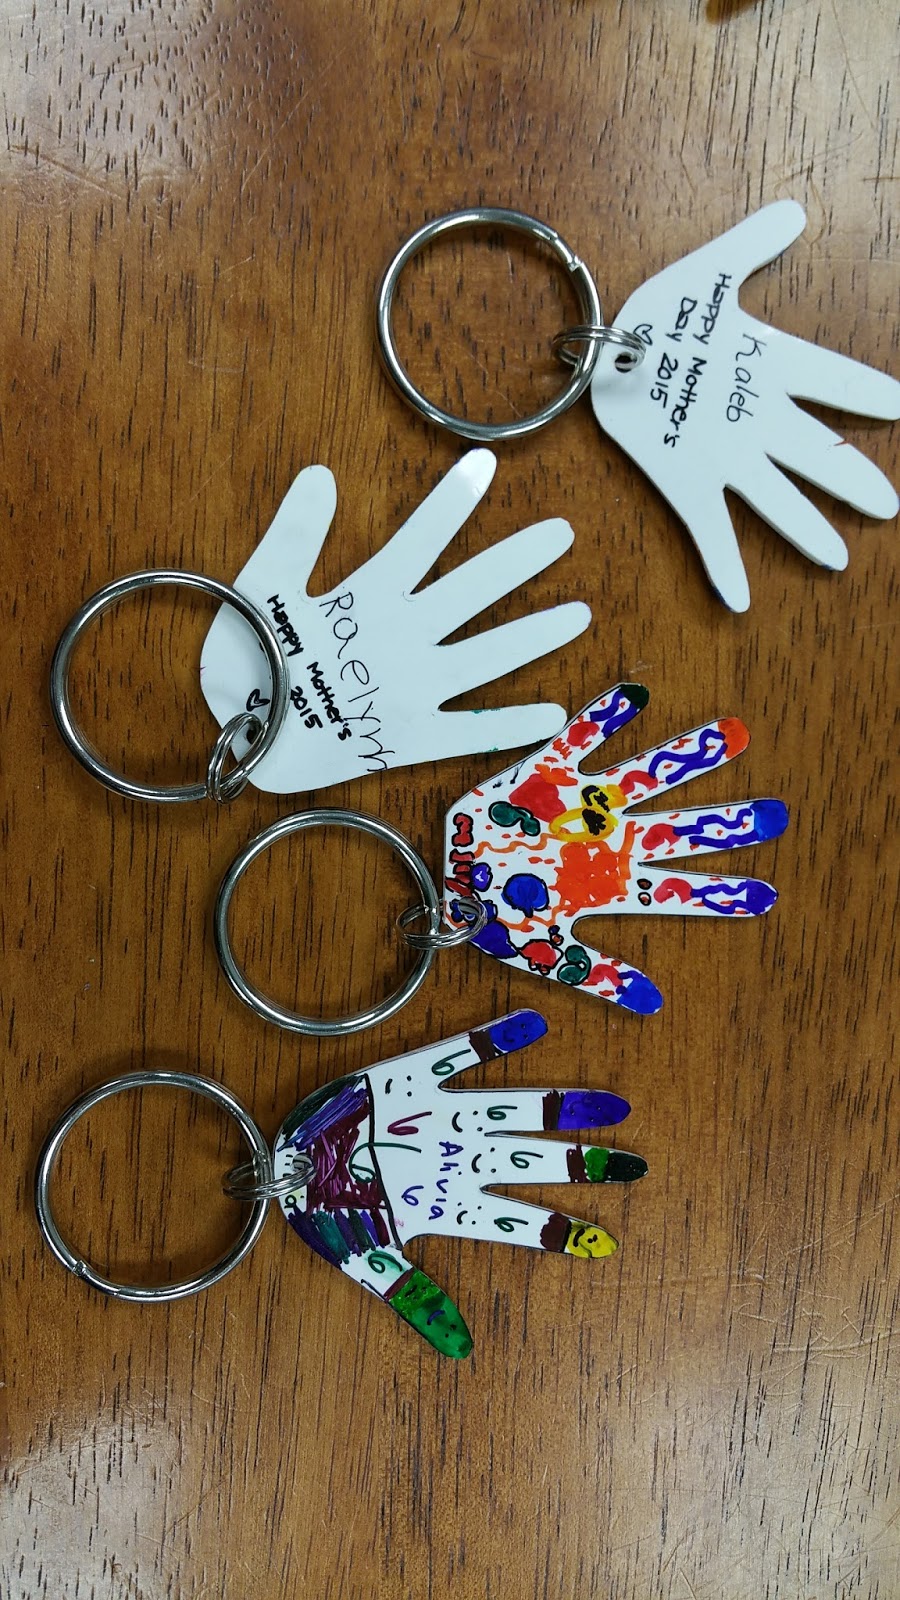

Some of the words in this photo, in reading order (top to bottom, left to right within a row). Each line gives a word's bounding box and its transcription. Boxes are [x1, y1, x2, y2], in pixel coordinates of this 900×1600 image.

[665, 296, 698, 342] Day
[692, 273, 732, 345] Happy
[650, 353, 679, 408] 2015
[663, 357, 707, 448] Mother's
[727, 333, 767, 423] Kaleb
[266, 593, 304, 657] Happy
[306, 661, 353, 741] Mother's
[289, 686, 323, 729] 2015
